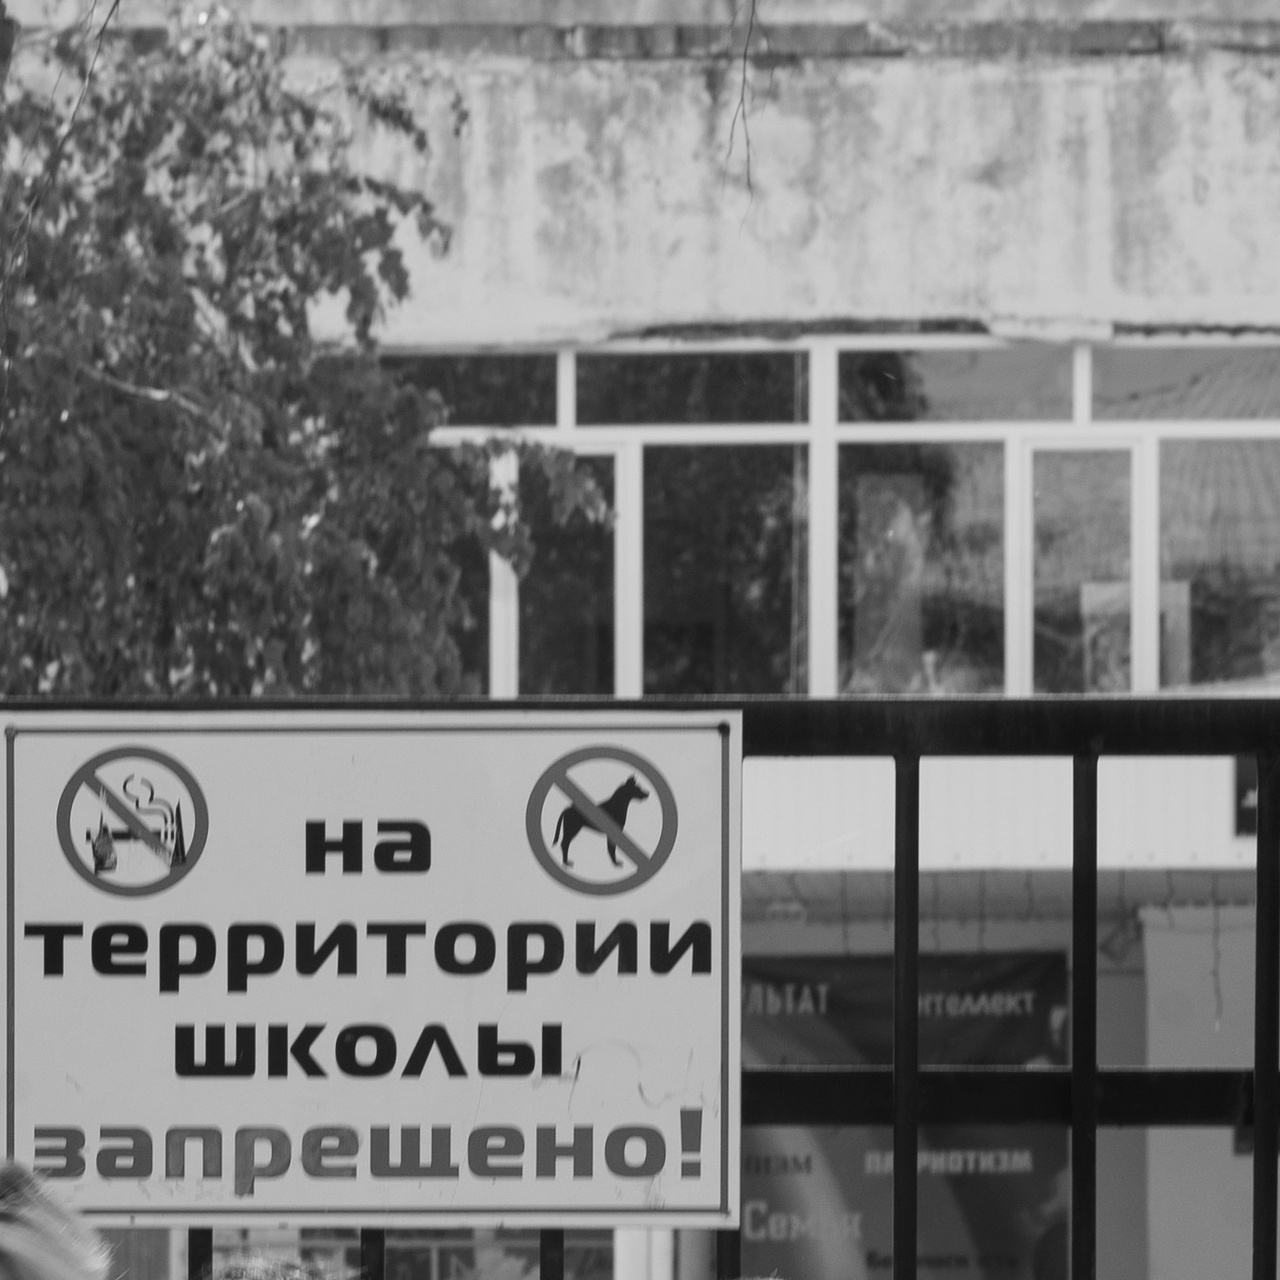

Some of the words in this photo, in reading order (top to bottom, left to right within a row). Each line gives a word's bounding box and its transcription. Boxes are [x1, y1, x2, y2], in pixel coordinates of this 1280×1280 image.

[306, 820, 431, 874] на
[24, 921, 712, 994] территории
[741, 982, 829, 1015] ЛЬТАТ
[175, 1023, 562, 1078] школы
[33, 1108, 702, 1196] запрещено!
